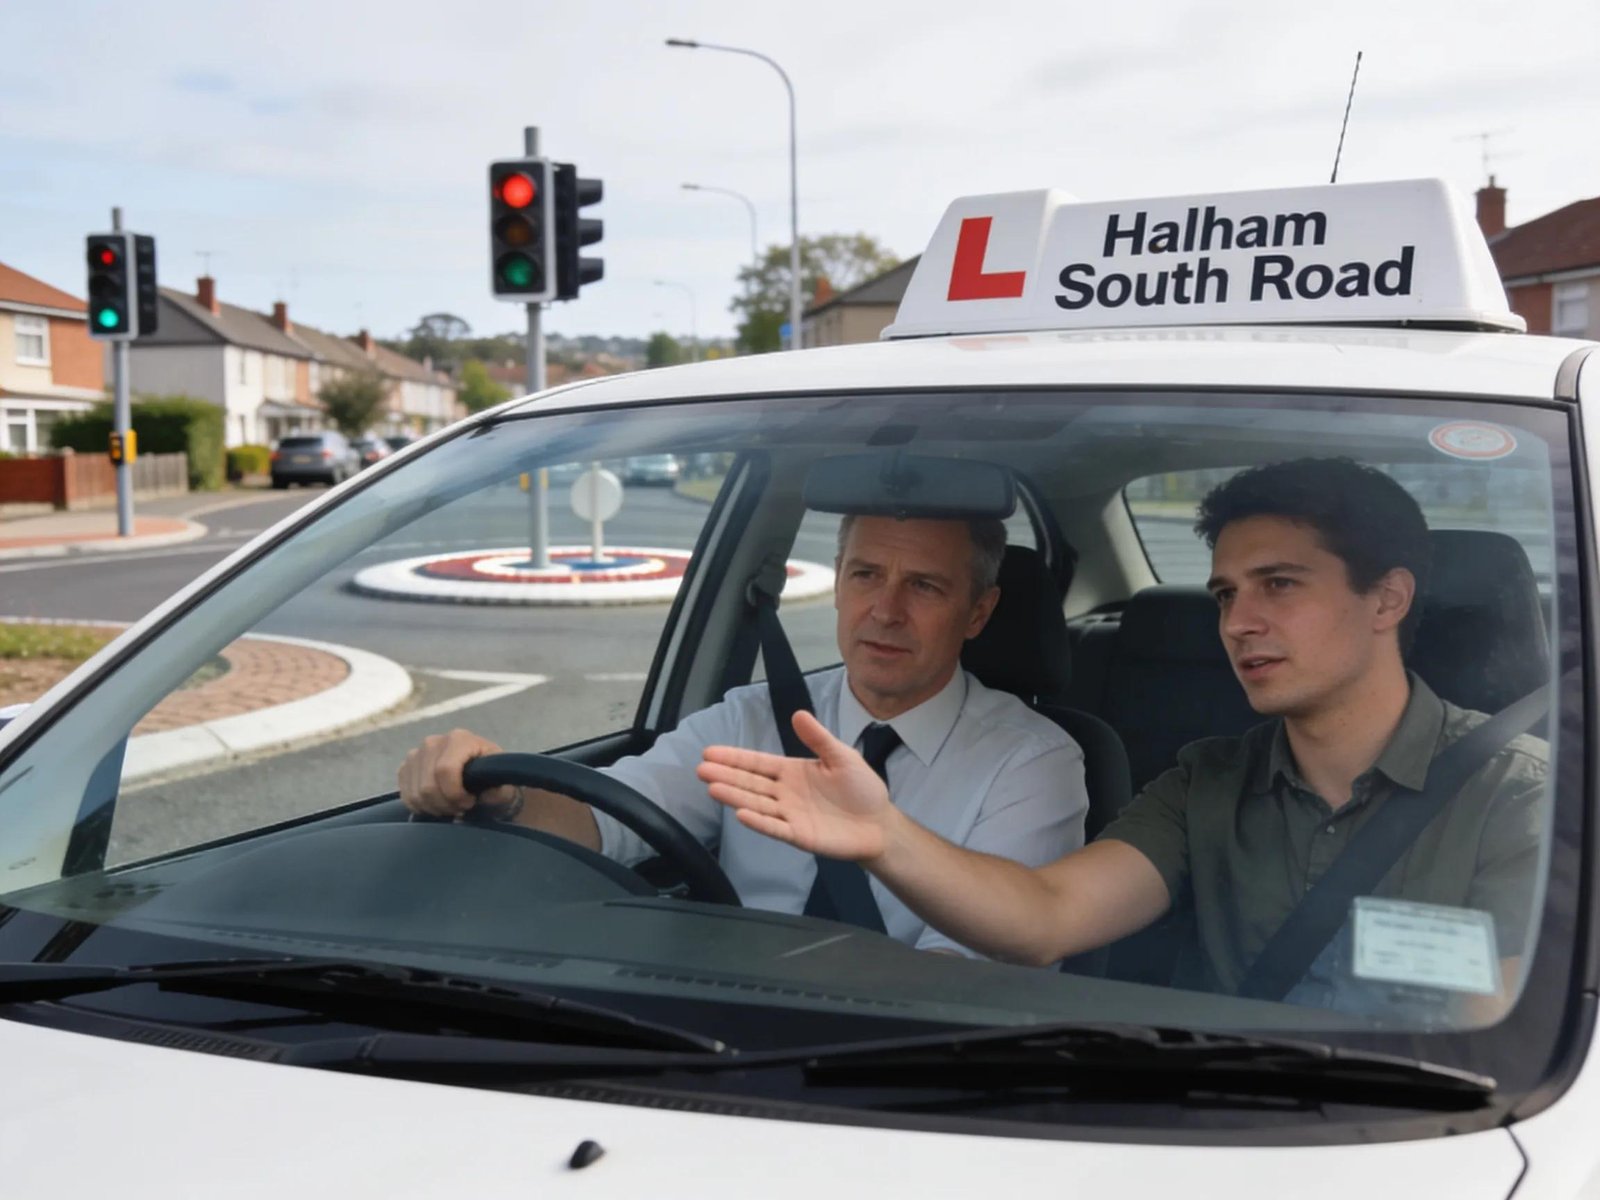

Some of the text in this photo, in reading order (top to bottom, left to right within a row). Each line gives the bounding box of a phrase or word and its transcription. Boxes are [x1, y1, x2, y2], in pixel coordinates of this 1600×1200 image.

[947, 216, 1027, 301] L
[1102, 205, 1327, 258] Halham
[1054, 245, 1416, 310] South Road
